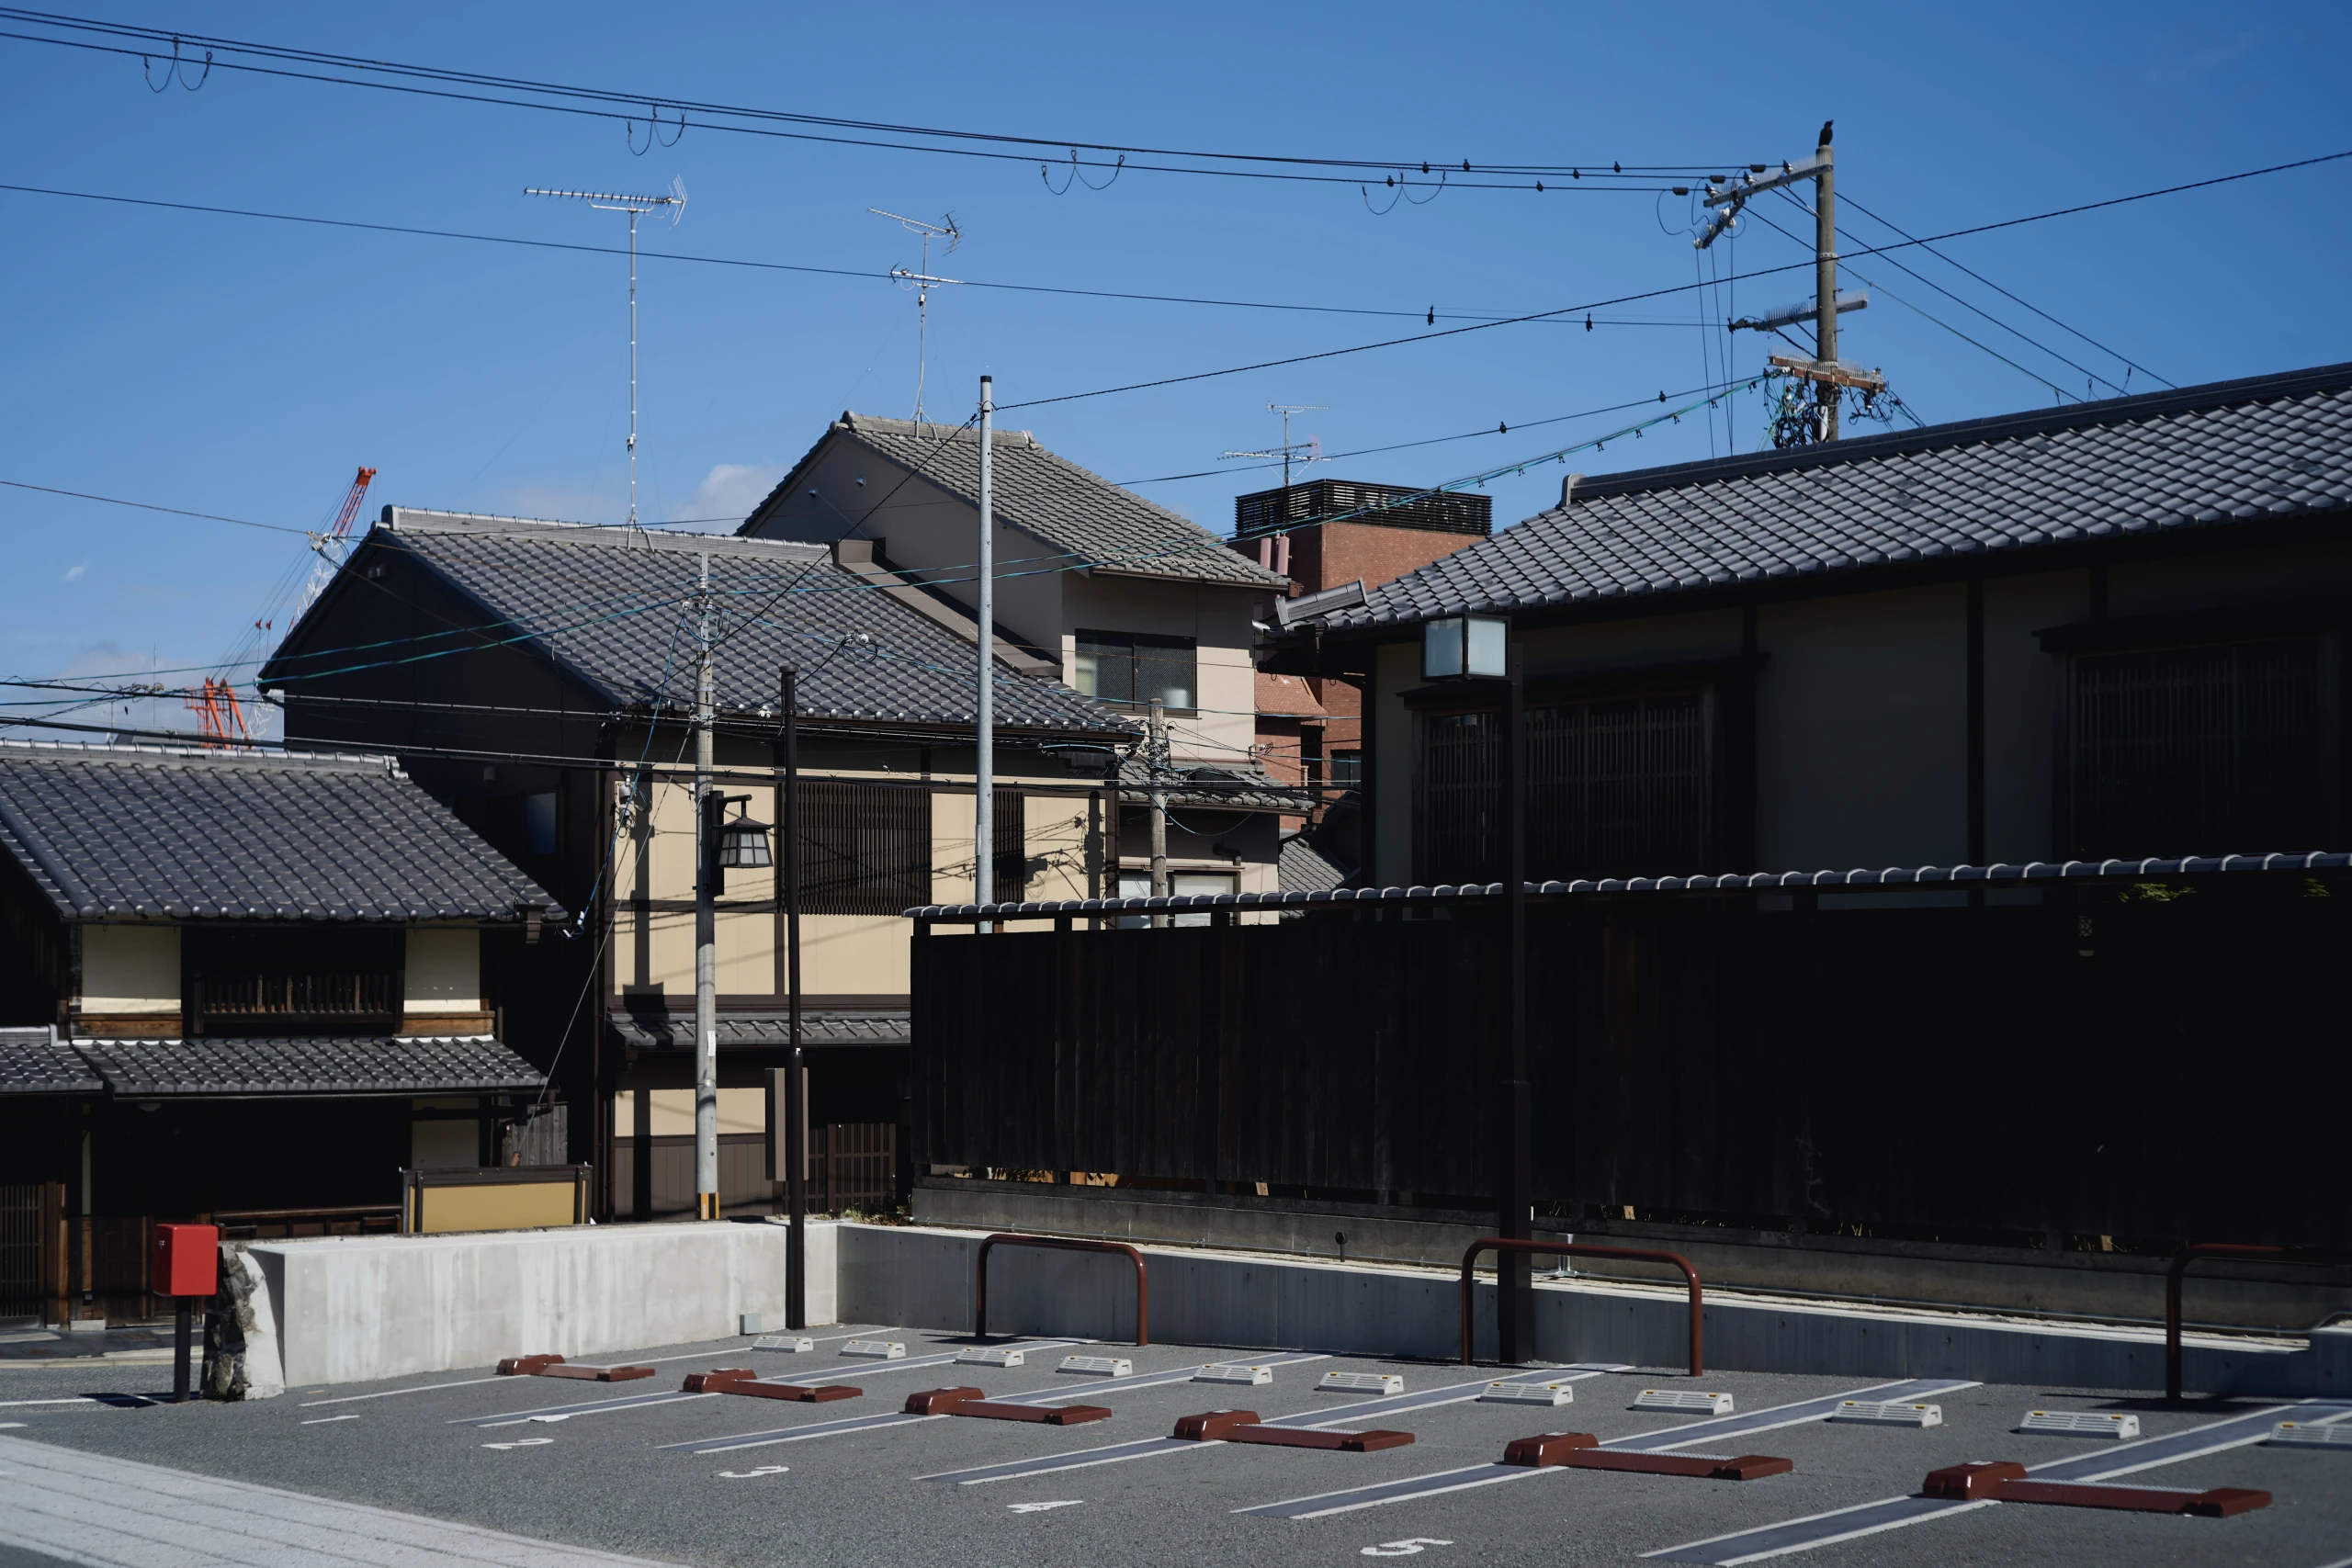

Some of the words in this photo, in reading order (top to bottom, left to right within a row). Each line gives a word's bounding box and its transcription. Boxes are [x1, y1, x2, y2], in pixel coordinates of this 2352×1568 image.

[481, 1438, 555, 1450] 2
[718, 1464, 790, 1479] 3
[1006, 1499, 1085, 1514] 4
[1360, 1537, 1454, 1557] 5
